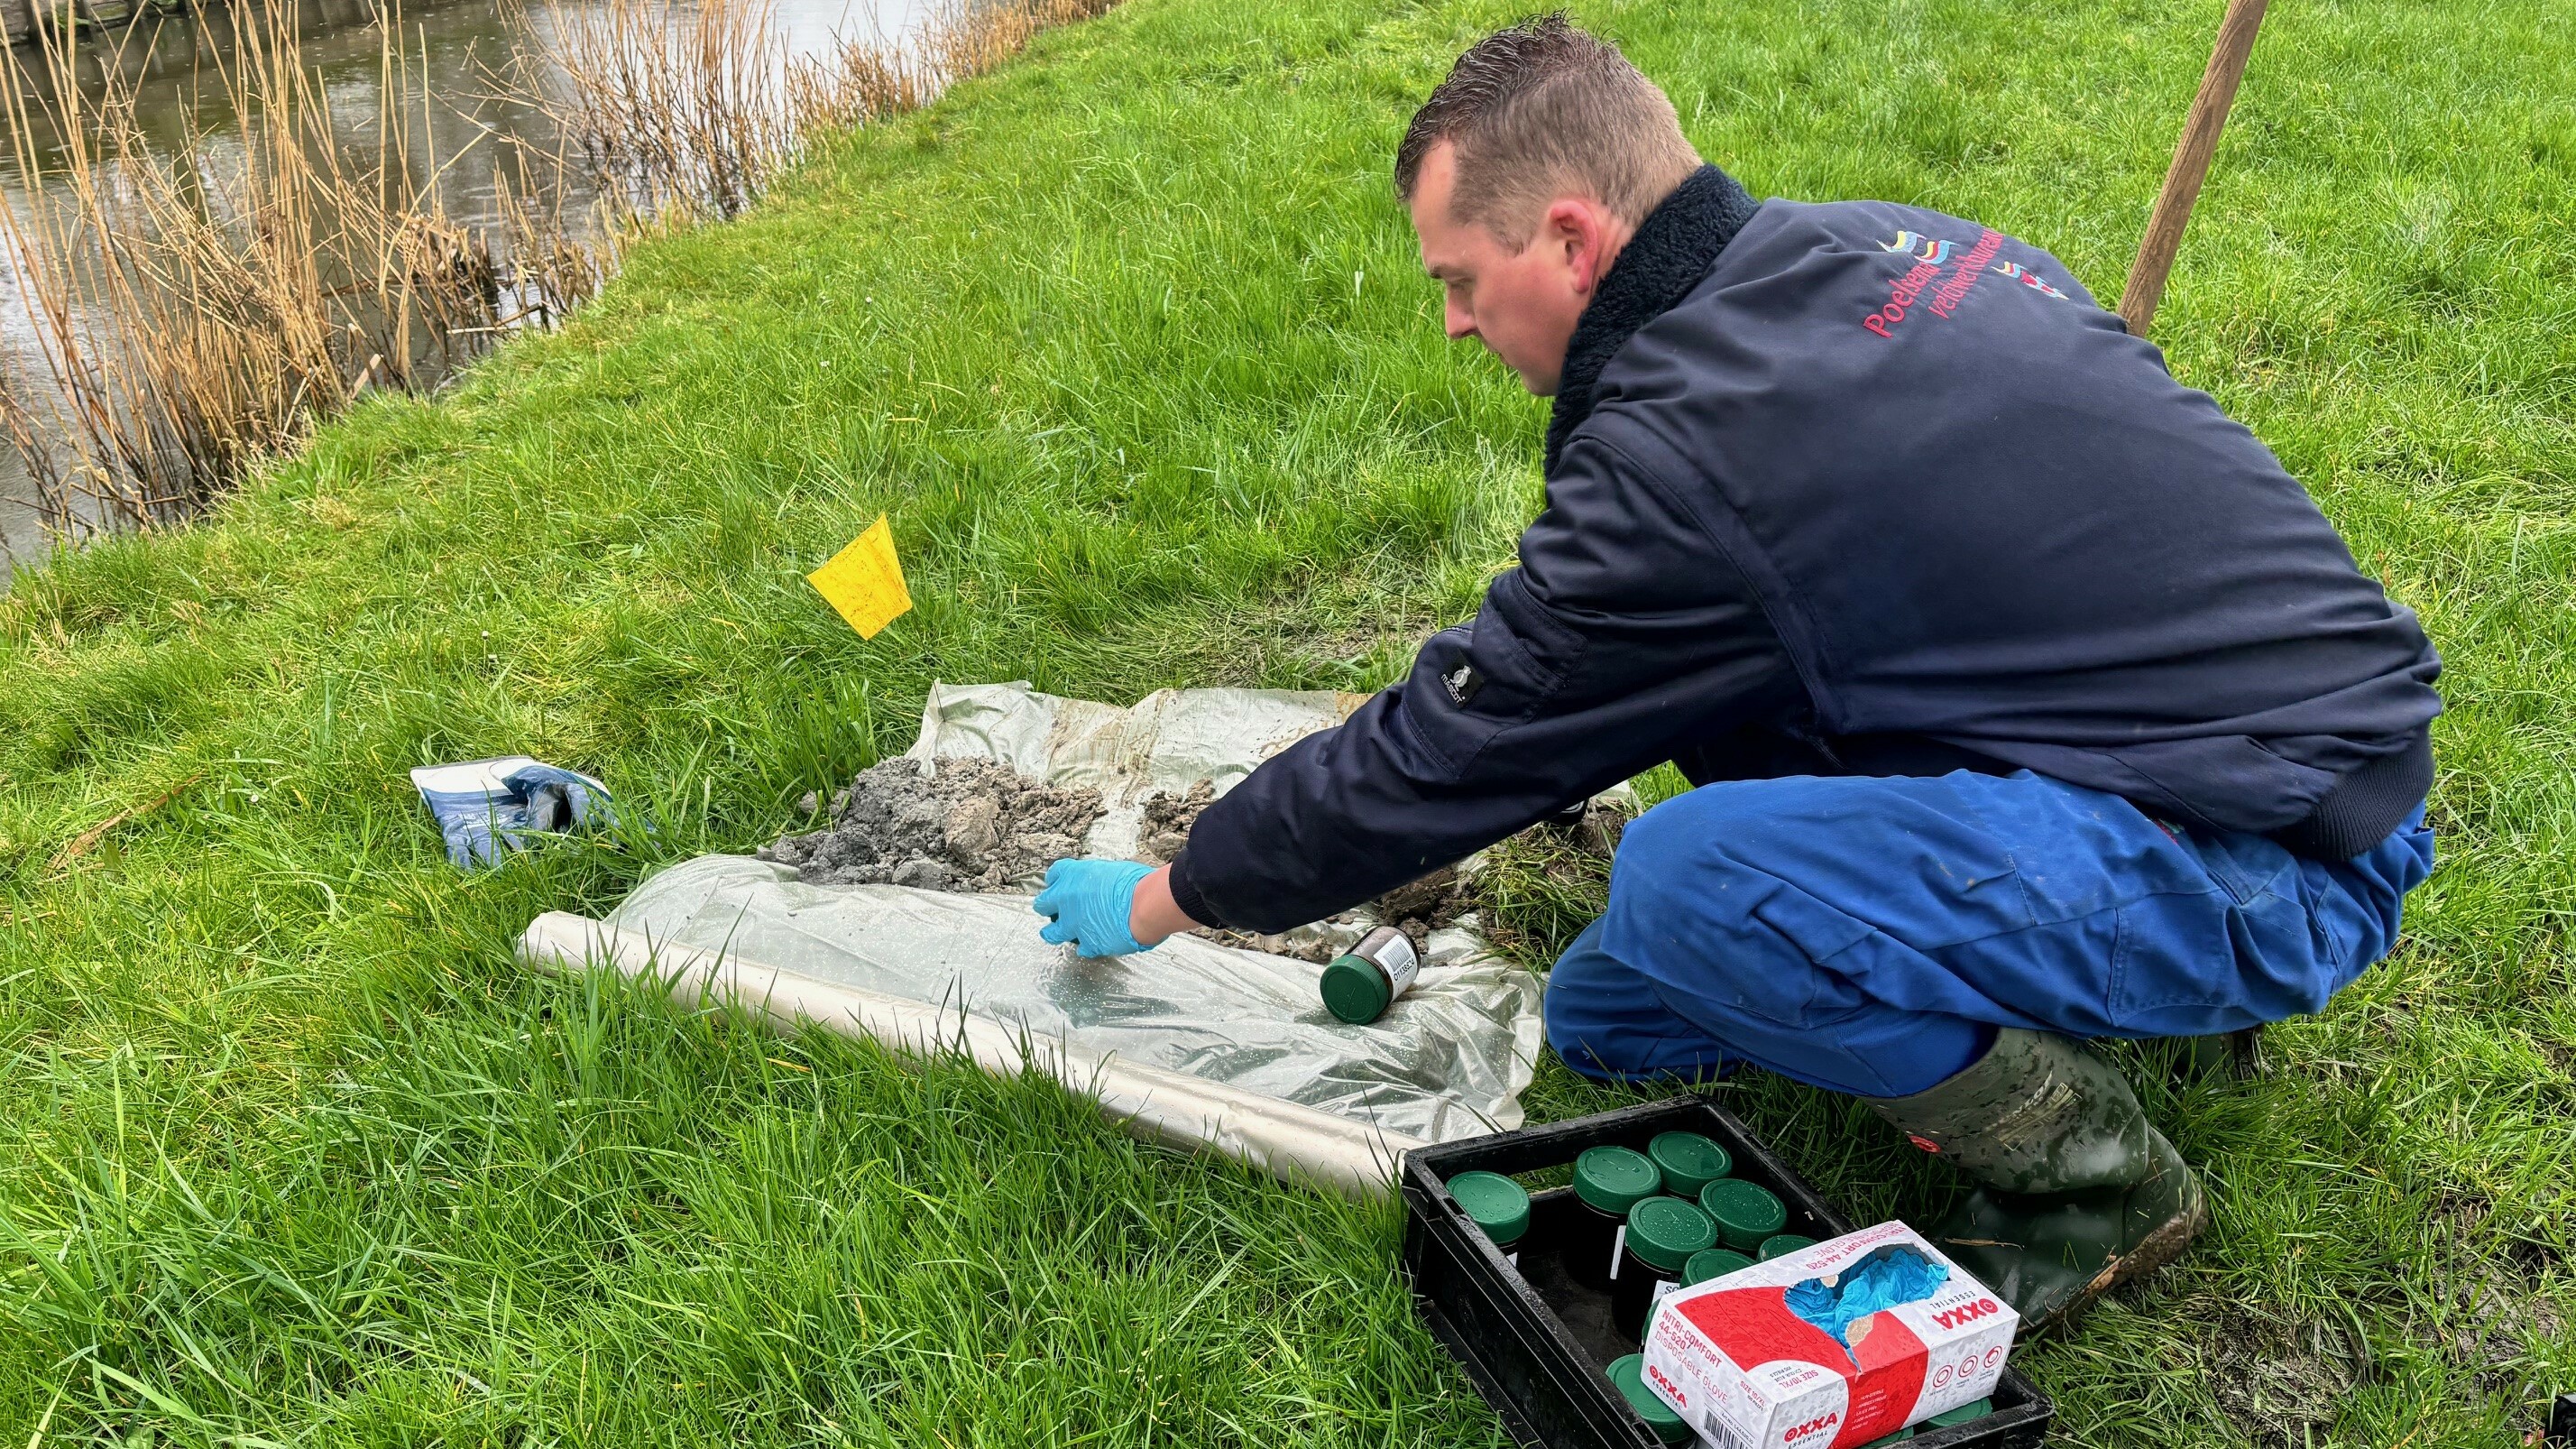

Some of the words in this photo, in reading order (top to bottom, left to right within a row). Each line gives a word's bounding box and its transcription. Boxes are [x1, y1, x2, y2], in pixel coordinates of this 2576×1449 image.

[1863, 262, 1941, 338] Poelsema
[1440, 673, 1463, 704] MASCOT
[1806, 1253, 1841, 1270] 44-520
[1813, 1241, 1845, 1257] GLOVE
[1930, 1290, 1976, 1309] ESSENTIAL
[1931, 1297, 1999, 1330] OXXA
[1659, 1320, 1687, 1351] 44-520
[1662, 1309, 1723, 1369] NITRI-COMFORT
[1654, 1331, 1703, 1380] DISPOSABLE
[1702, 1375, 1728, 1405] GLOVE
[1779, 1376, 1802, 1389] 10/XL
[1799, 1370, 1819, 1381] SIZE
[1649, 1364, 1688, 1409] OXXA
[1652, 1380, 1682, 1411] ESSENTIAL
[1740, 1380, 1753, 1394] SIZE
[1752, 1390, 1766, 1407] 10/XL
[1784, 1412, 1837, 1443] OXXA
[1788, 1430, 1827, 1449] ESSENTIAL
